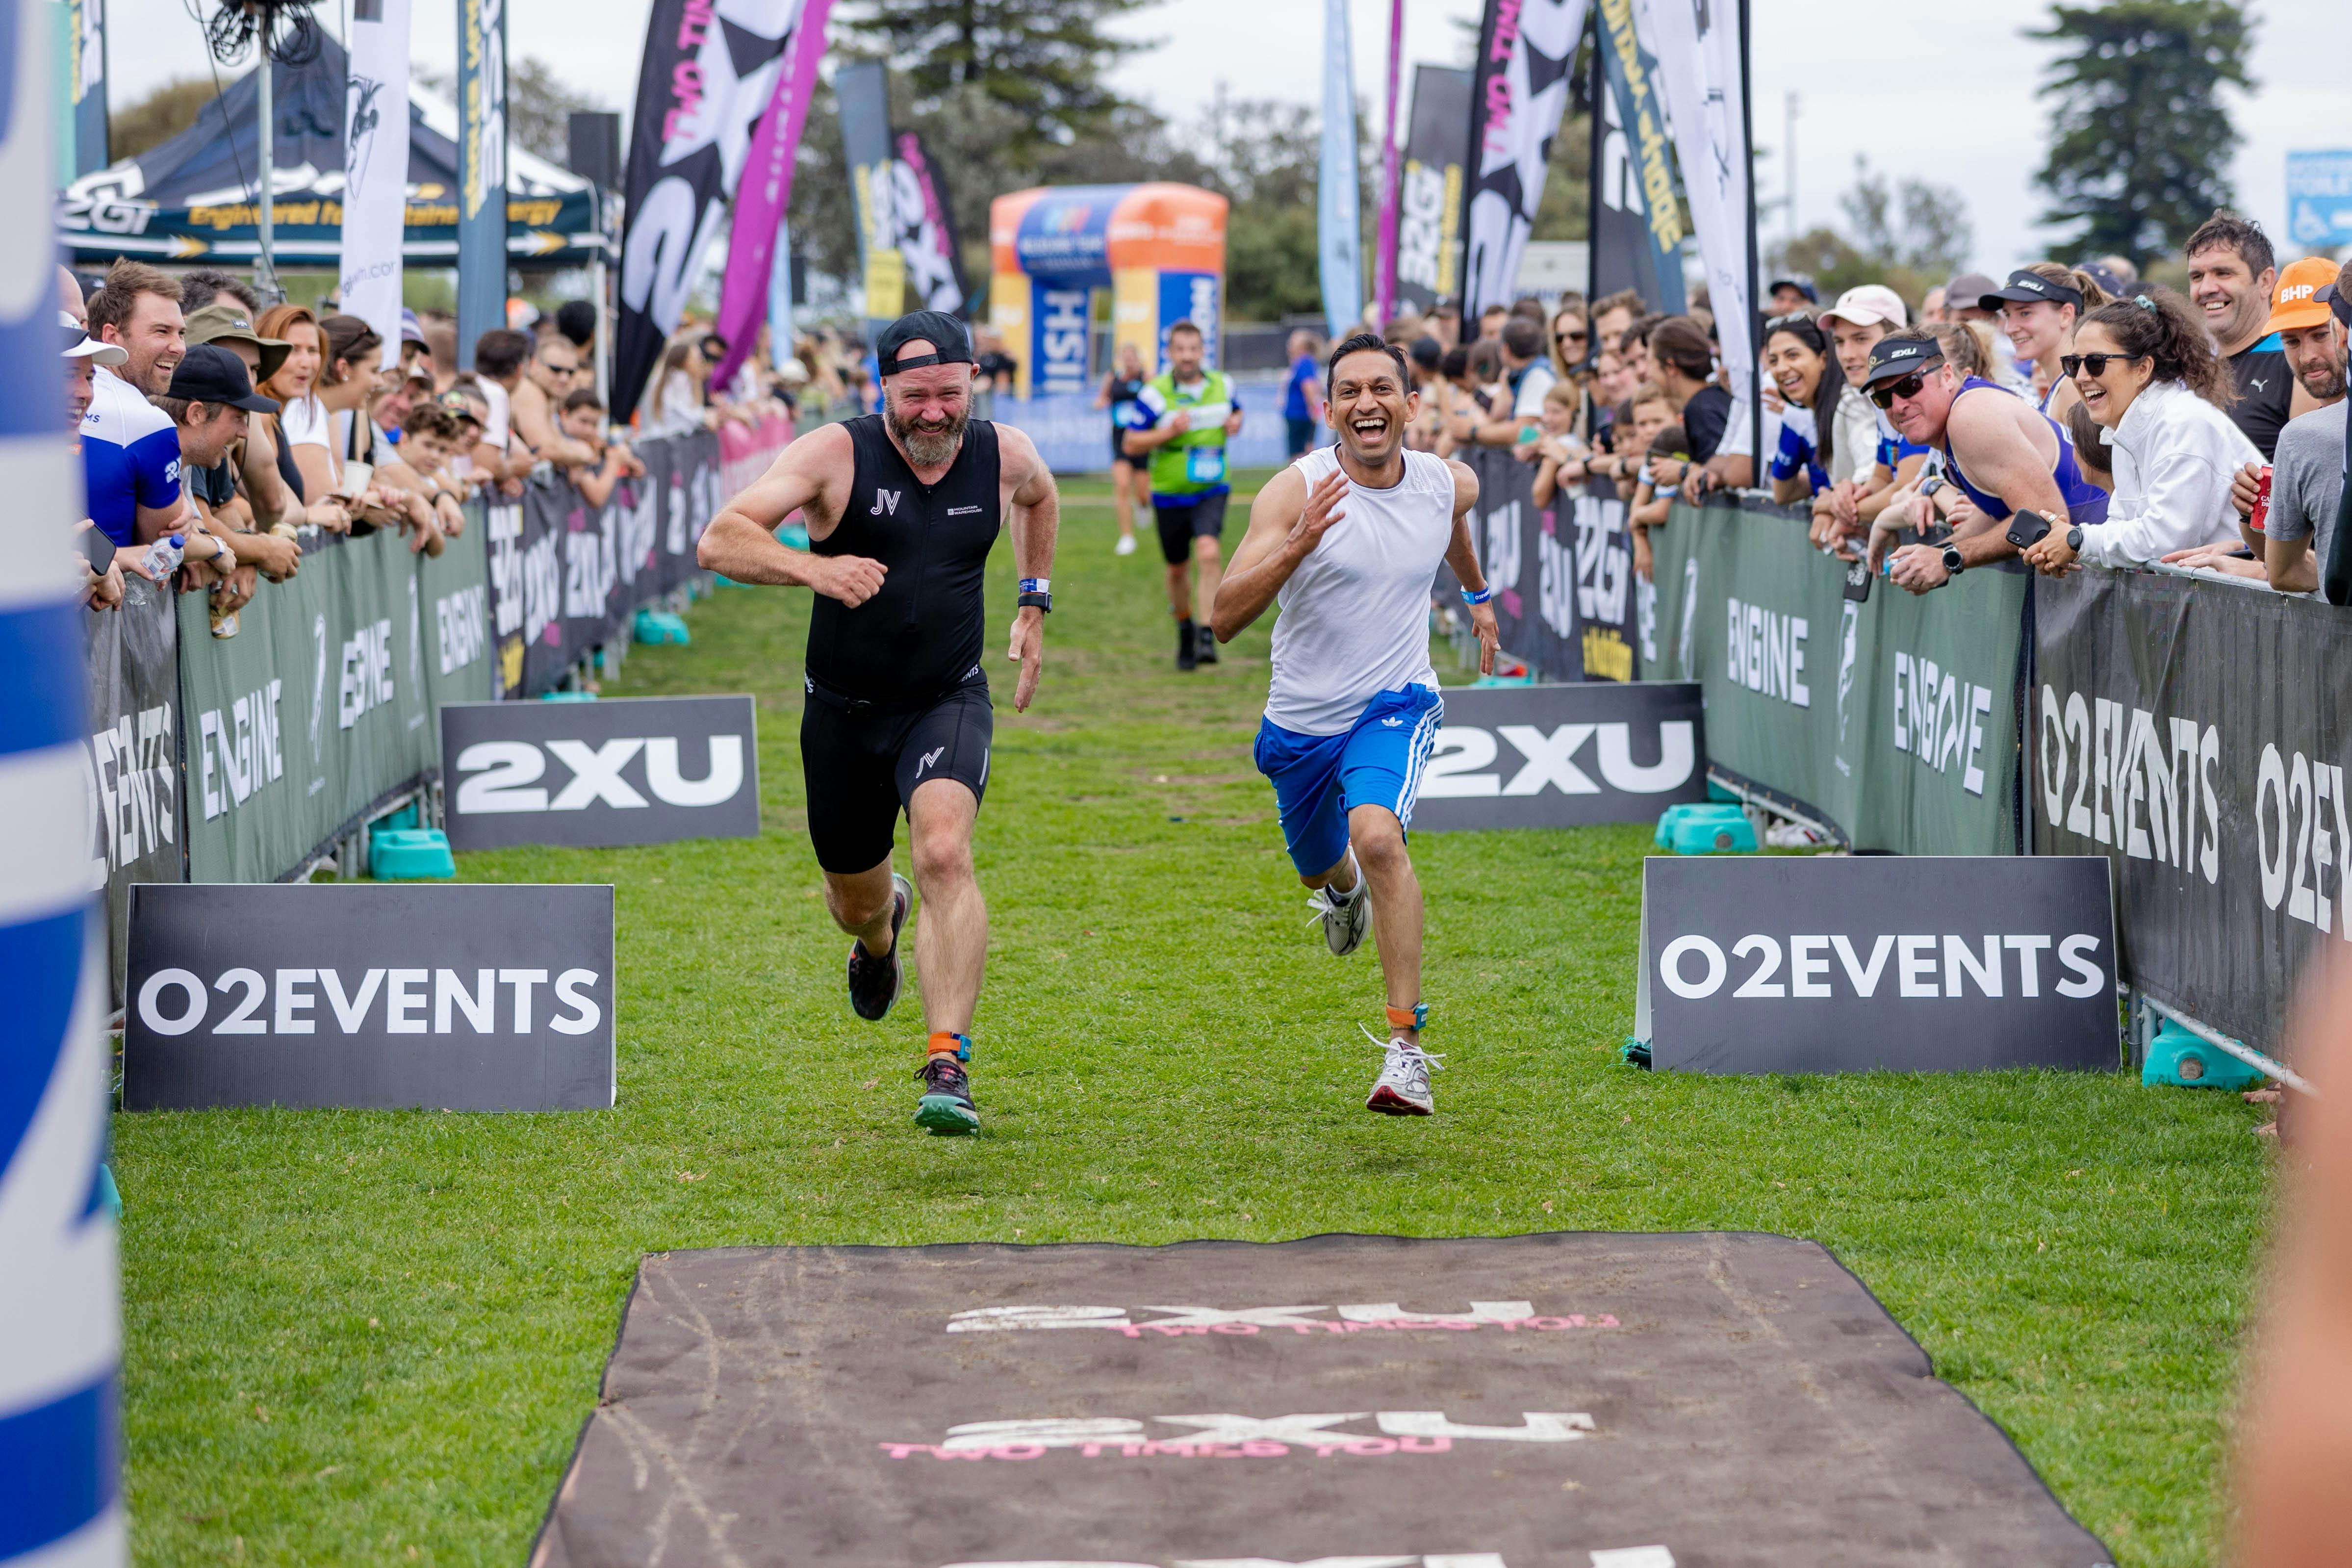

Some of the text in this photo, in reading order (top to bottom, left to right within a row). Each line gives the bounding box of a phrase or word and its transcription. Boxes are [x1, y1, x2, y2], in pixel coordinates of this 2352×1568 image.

[662, 59, 707, 143] TWO
[1482, 74, 1513, 153] TWO
[2017, 280, 2044, 292] 2XU
[2281, 284, 2313, 304] BHP
[1891, 347, 1917, 359] 2XU
[870, 488, 901, 515] JV
[1726, 597, 1811, 709] ENGINE
[200, 678, 283, 821] ENGINE
[456, 734, 744, 815] 2XU
[916, 746, 945, 779] JV
[1415, 720, 1695, 799] 2XU
[2041, 684, 2219, 884] O2EVENTS
[1660, 933, 2105, 999] O2EVENTS
[138, 968, 601, 1035] O2EVENTS
[946, 1300, 1536, 1334] 2XU
[877, 1436, 1454, 1461] TWO TIMES YOU
[942, 1410, 1595, 1450] 2XU
